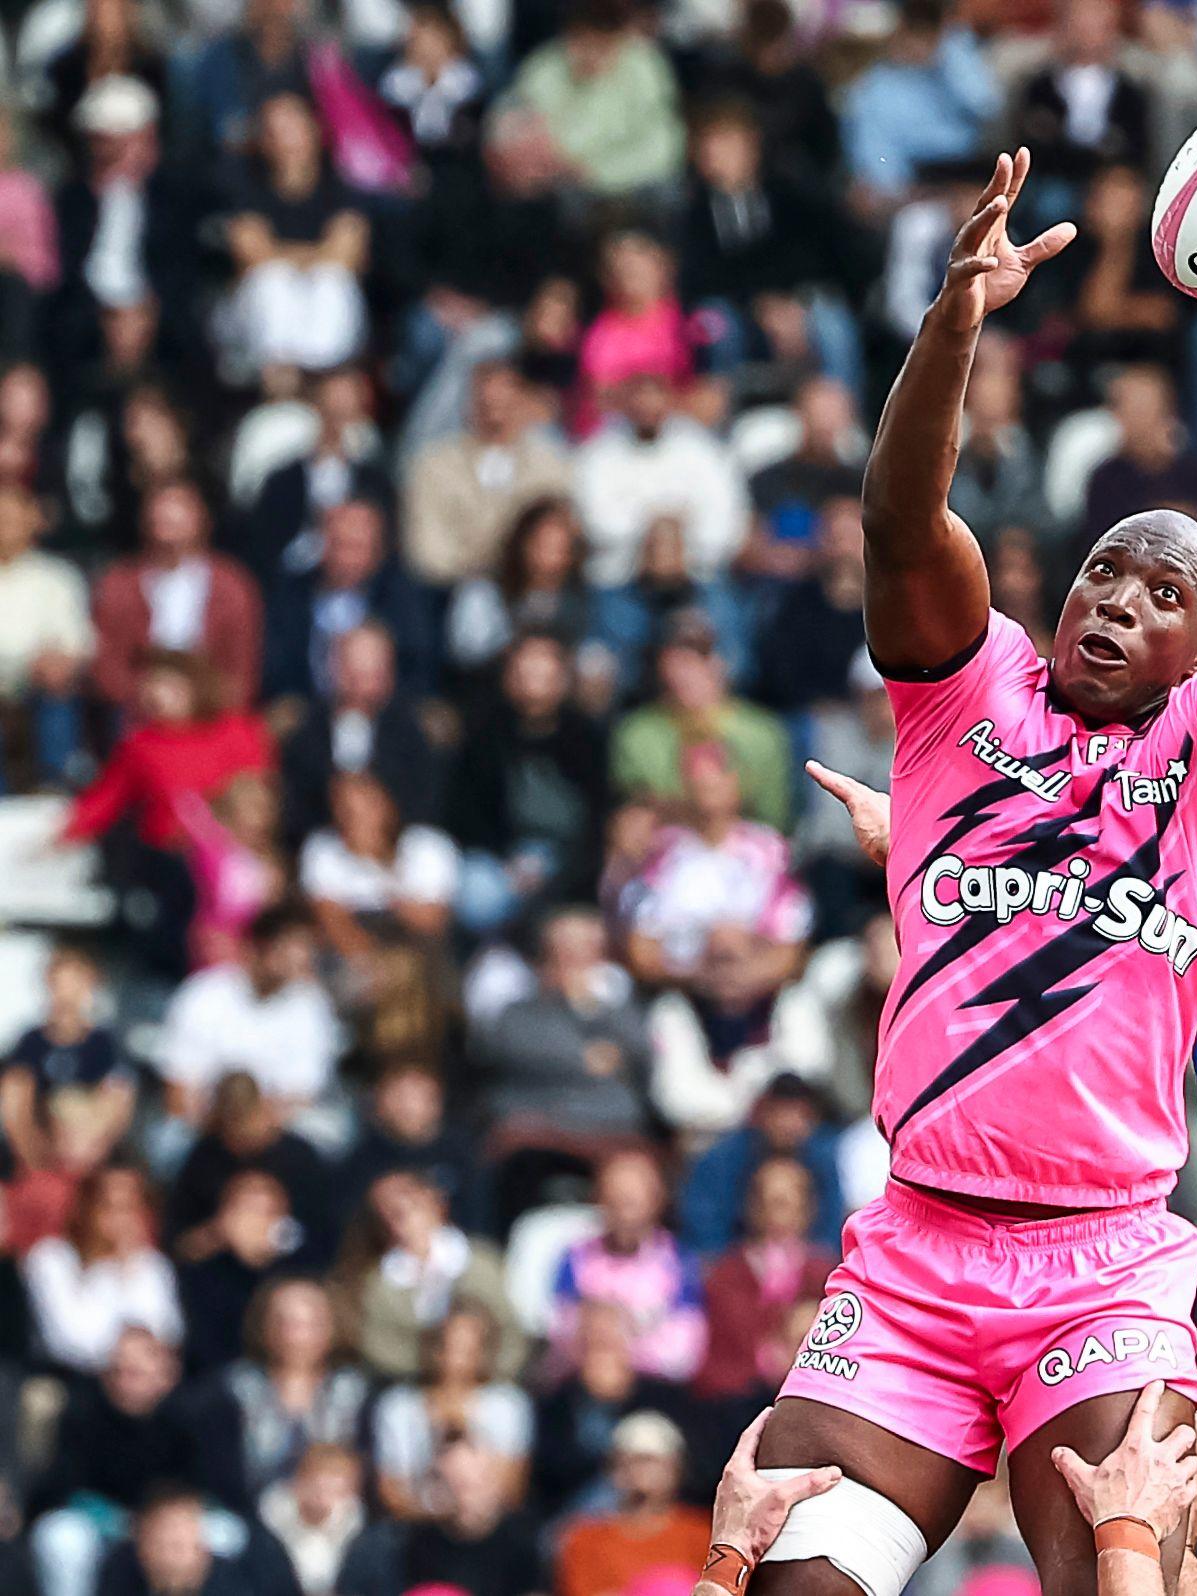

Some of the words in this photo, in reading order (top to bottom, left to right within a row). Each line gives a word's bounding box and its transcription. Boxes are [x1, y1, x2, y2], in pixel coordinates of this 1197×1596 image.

[957, 718, 1072, 803] Airwell
[793, 1350, 859, 1381] RANN
[1037, 1328, 1178, 1387] QAPA
